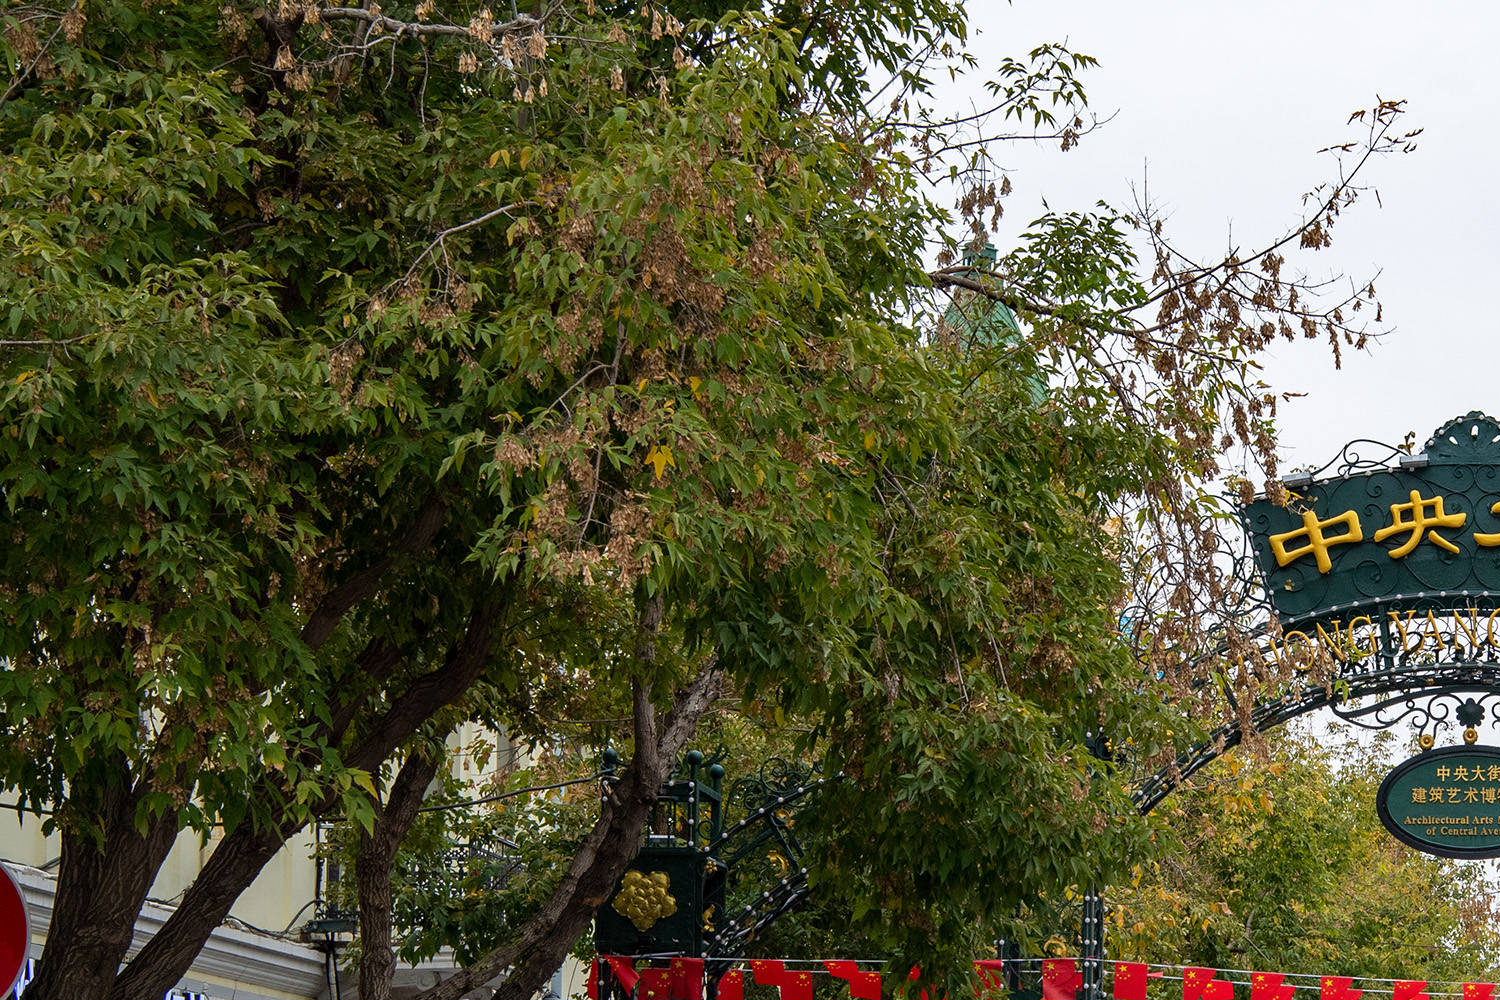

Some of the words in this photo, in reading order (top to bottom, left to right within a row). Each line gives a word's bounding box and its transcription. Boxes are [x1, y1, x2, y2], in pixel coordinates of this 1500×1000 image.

[1404, 815, 1469, 825] Architectural
[1471, 815, 1493, 825] Arts
[1426, 826, 1436, 836] of
[1440, 826, 1477, 836] Central
